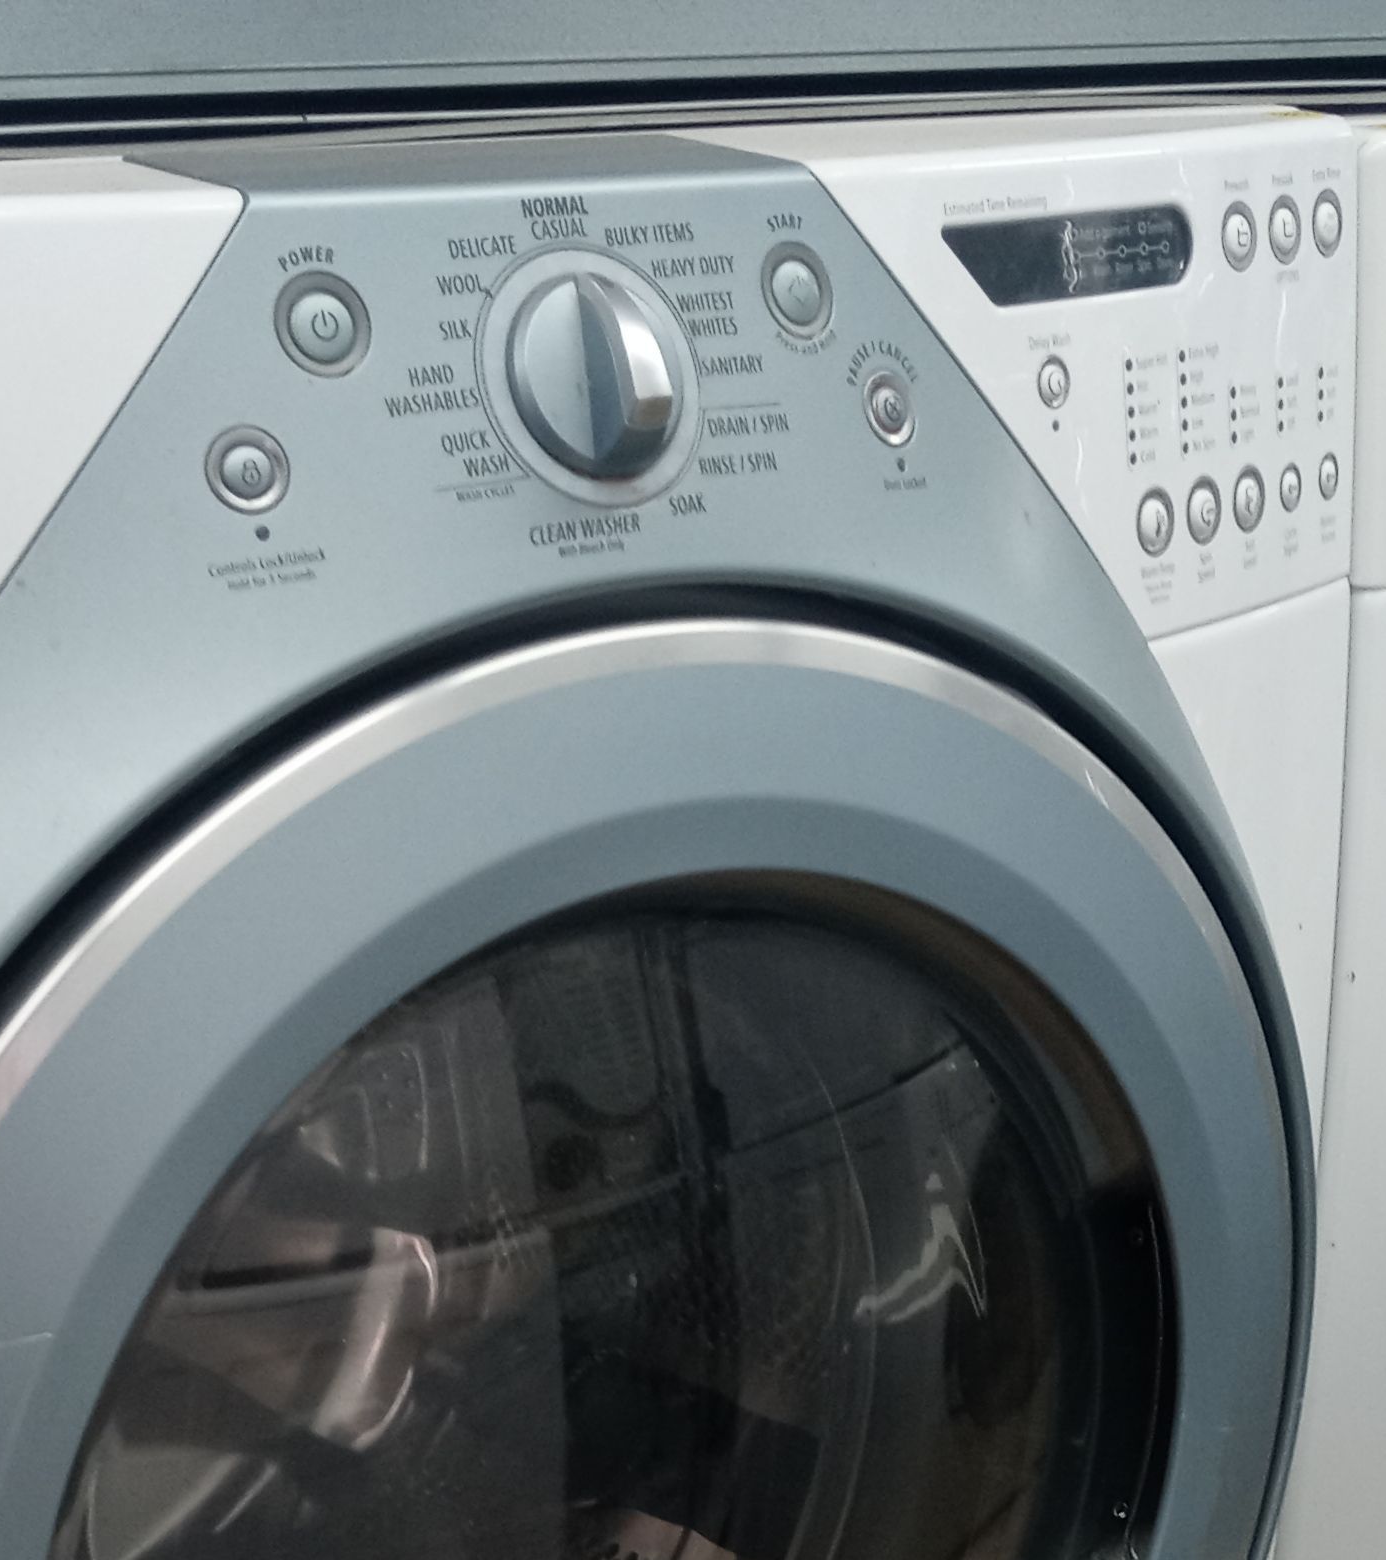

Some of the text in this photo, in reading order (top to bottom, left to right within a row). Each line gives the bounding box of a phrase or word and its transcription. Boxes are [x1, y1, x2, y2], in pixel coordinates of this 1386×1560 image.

[520, 195, 589, 219] NORMAL
[530, 217, 589, 241] CASUAL
[604, 222, 695, 248] BULKY ITEMS
[766, 212, 803, 233] START
[278, 245, 335, 273] POWER
[448, 235, 517, 260] DELICATE
[650, 255, 735, 280] HEAVY DUTY
[436, 274, 485, 296] WOOL
[675, 291, 735, 313] WHITEST
[439, 319, 473, 341] SILK
[687, 316, 738, 338] WHITES
[408, 364, 454, 387] HAND
[701, 355, 764, 378] SANITARY
[846, 343, 871, 386] PAUSE
[878, 340, 919, 382] CANCEL
[384, 387, 480, 418] WASHABLES
[707, 416, 749, 439] DRAIN
[760, 412, 790, 435] SPIN
[440, 429, 492, 455] QUICK
[462, 454, 512, 479] WASH
[699, 454, 737, 476] RINSE
[748, 451, 779, 474] SPIN
[668, 492, 708, 517] SOAK
[529, 513, 641, 547] CLEAN WASHER
